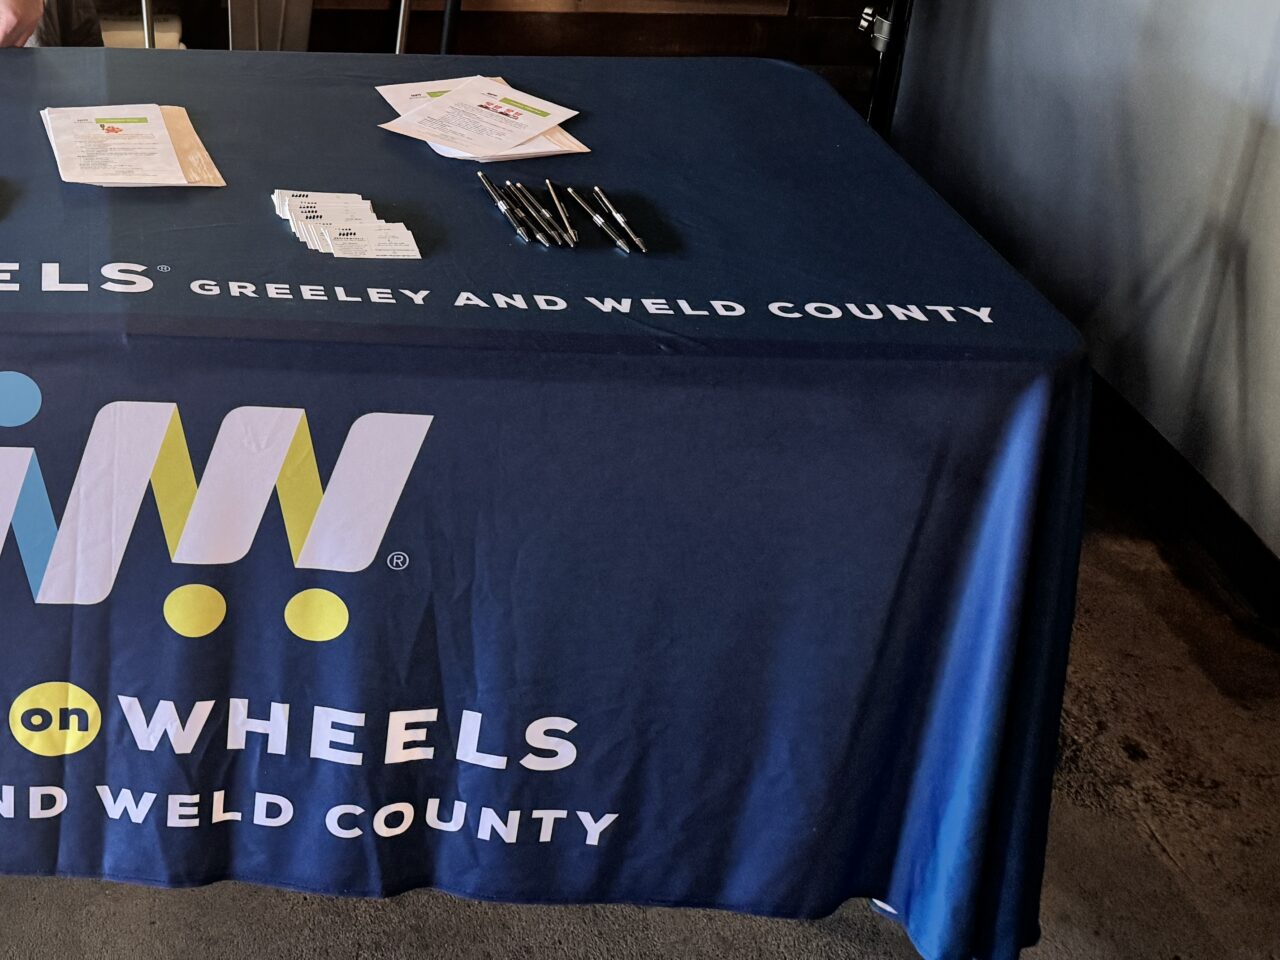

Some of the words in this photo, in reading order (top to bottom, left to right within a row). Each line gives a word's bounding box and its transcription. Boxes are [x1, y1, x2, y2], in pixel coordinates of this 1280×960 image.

[189, 279, 431, 305] GREELEY
[453, 291, 568, 311] AND
[584, 296, 746, 317] WELD
[767, 301, 995, 324] COUNTY
[20, 705, 89, 732] on
[116, 694, 579, 772] WHEELS
[95, 784, 294, 828] WELD
[325, 797, 619, 846] COUNTY
